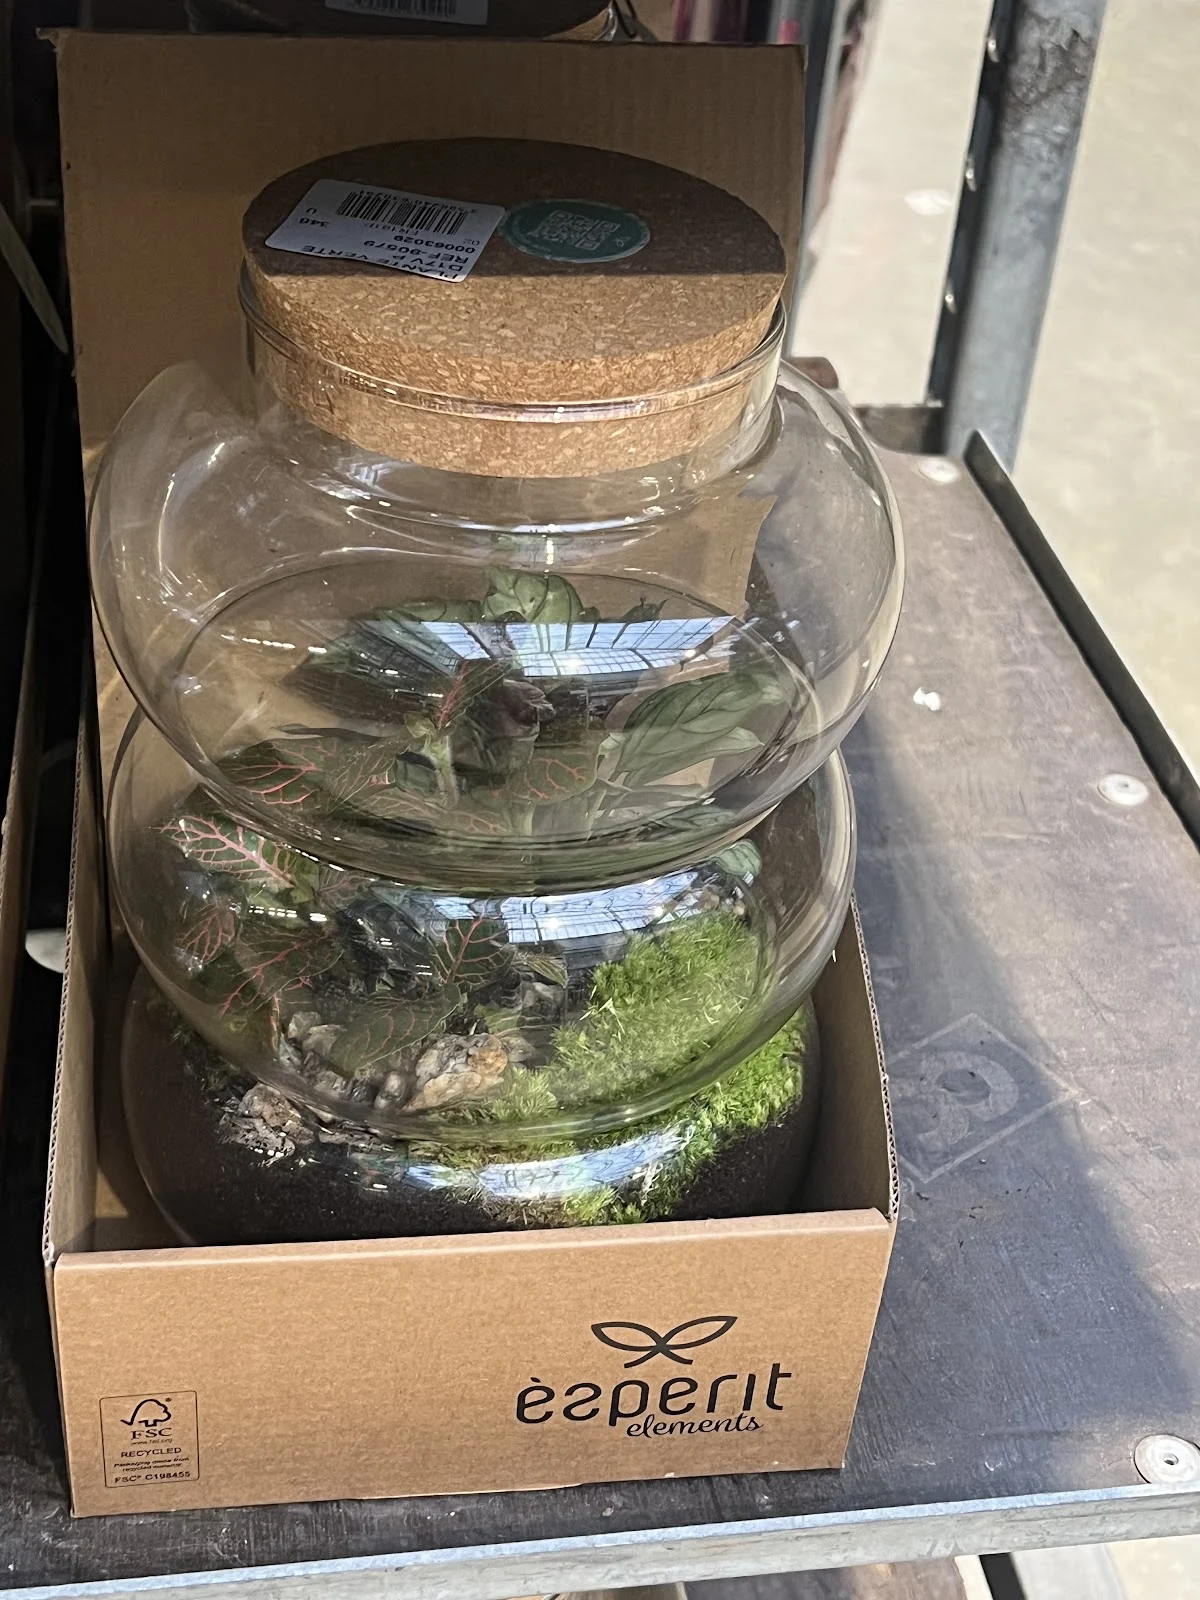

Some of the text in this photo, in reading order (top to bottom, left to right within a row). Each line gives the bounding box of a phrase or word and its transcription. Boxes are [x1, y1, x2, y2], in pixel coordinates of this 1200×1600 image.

[394, 236, 476, 254] 00063029
[300, 246, 369, 260] VERTE
[626, 1412, 764, 1438] elements
[131, 1427, 172, 1440] FSC
[120, 1447, 182, 1458] RECYCLED
